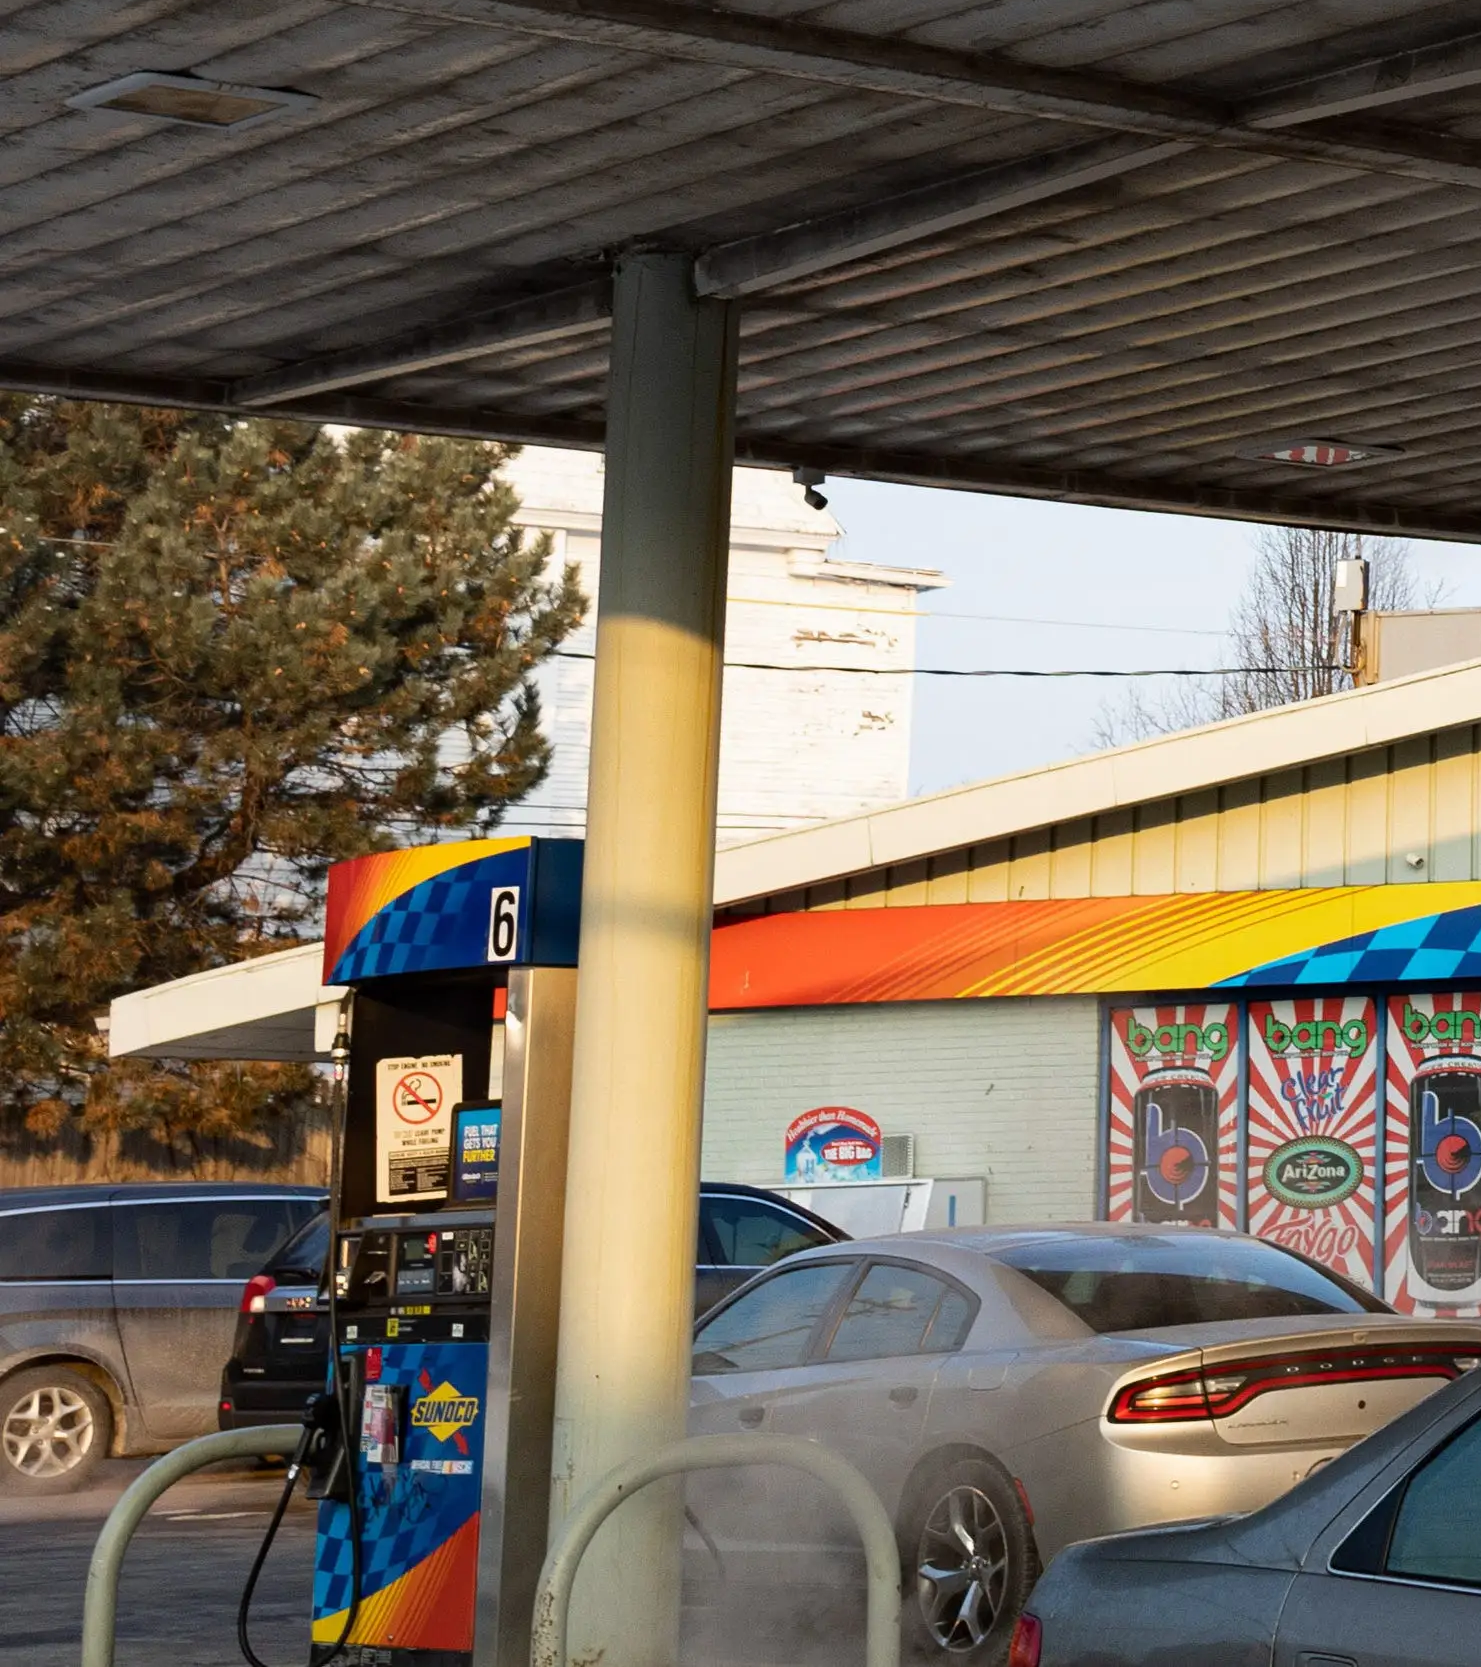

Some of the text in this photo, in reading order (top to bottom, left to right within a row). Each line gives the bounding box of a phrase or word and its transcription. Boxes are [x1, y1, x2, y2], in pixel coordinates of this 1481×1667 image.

[492, 890, 516, 957] 6
[1126, 1018, 1229, 1062] bang
[1265, 1014, 1367, 1058] bang
[1280, 1066, 1345, 1103] Clear
[1295, 1085, 1347, 1130] fruit
[464, 1125, 479, 1137] FUEL
[463, 1137, 497, 1149] GETS YOU
[839, 1146, 854, 1160] BIG
[856, 1146, 872, 1159] BAG
[1281, 1163, 1345, 1183] AriZona
[1286, 1354, 1423, 1373] DODGE
[413, 1400, 477, 1423] SUNOCO
